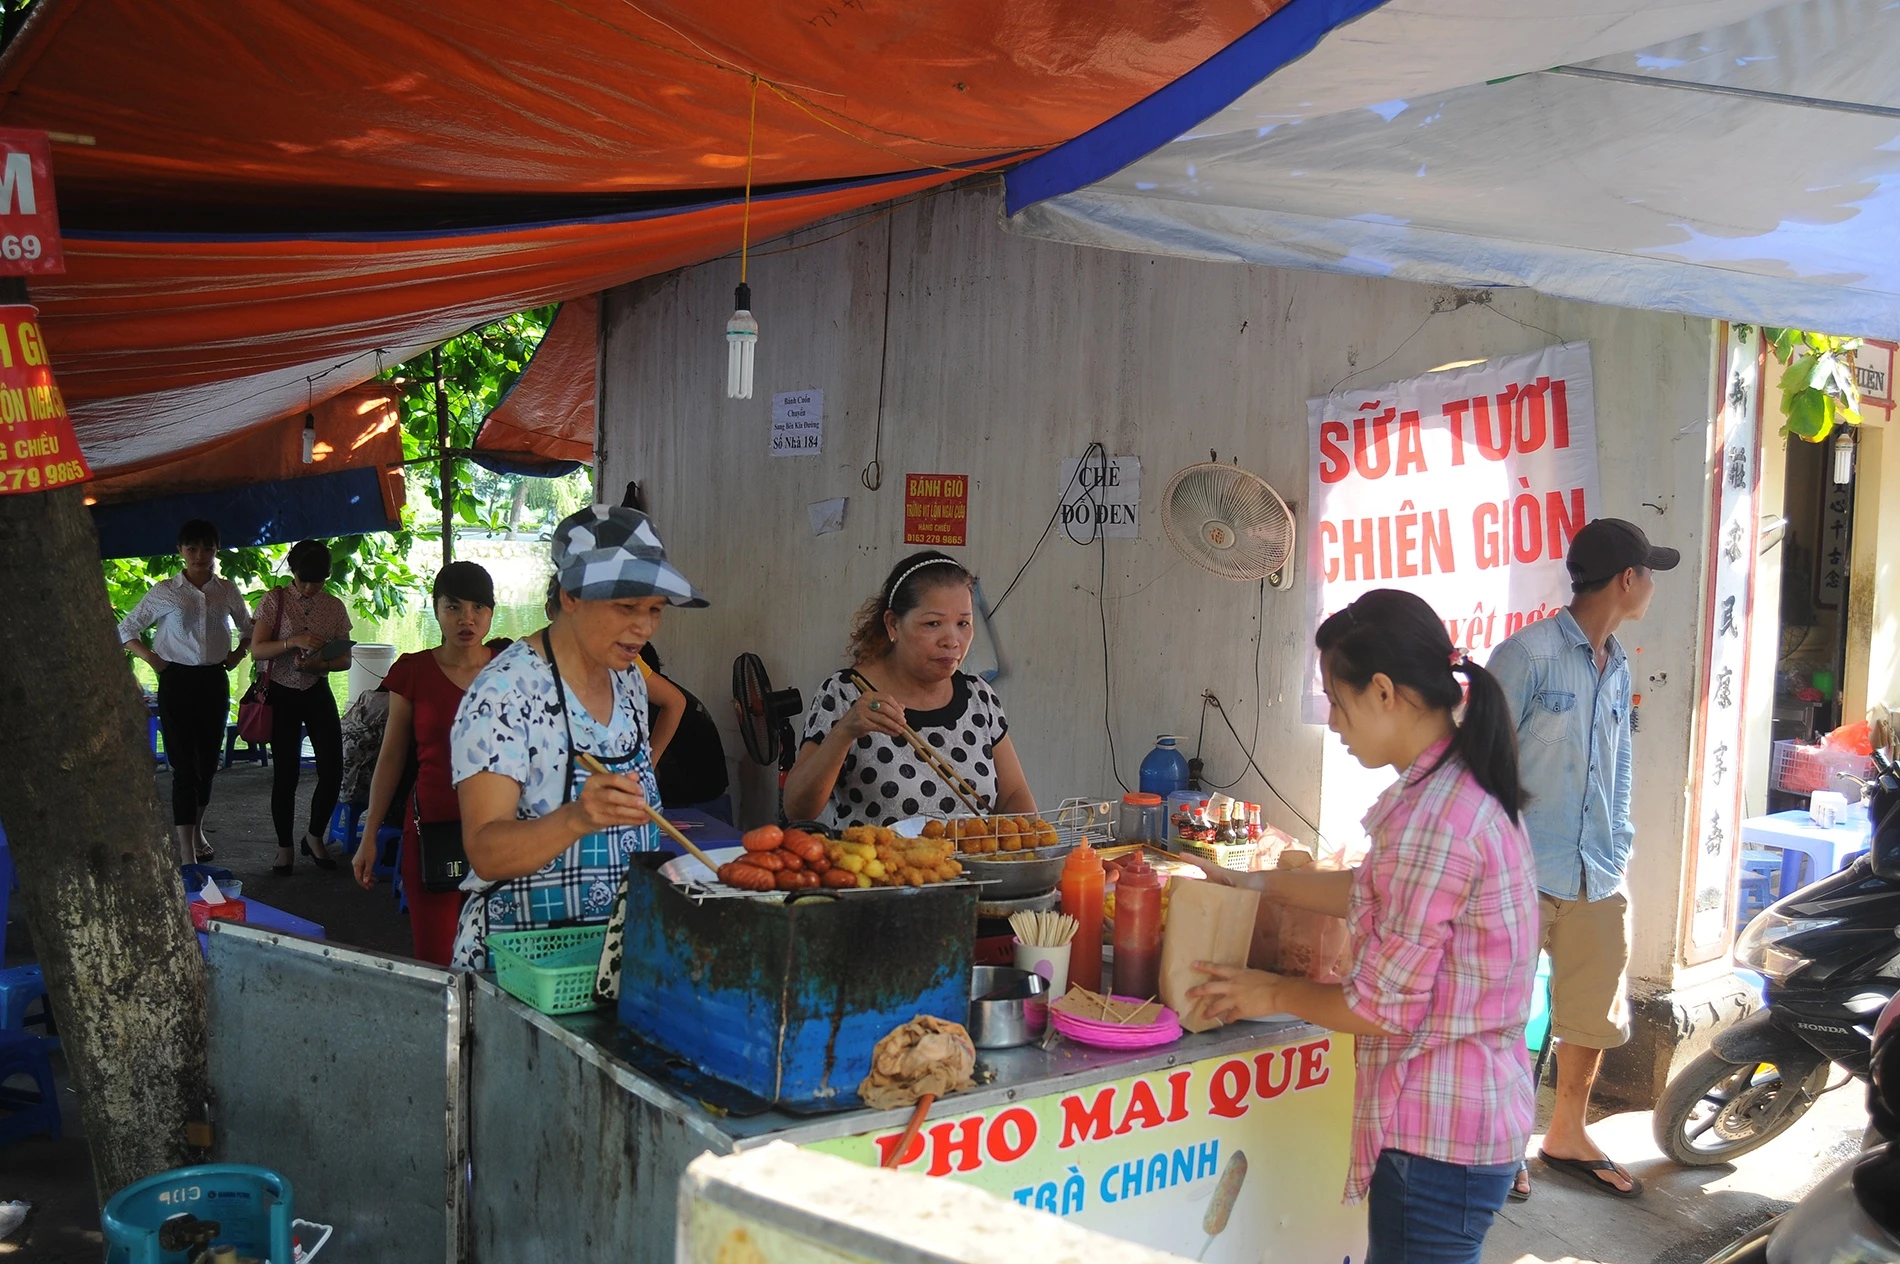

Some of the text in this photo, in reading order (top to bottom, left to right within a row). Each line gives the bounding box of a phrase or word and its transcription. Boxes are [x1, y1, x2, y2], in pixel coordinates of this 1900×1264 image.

[0, 234, 42, 260] 69
[0, 382, 28, 431] ỘN
[773, 433, 818, 450] Số Nhà 184
[1319, 376, 1569, 484] SỮA TƯƠI
[45, 460, 85, 485] 9865
[1078, 461, 1120, 488] CHÈ
[909, 476, 964, 498] BÁNH GIÒ
[1060, 498, 1137, 525] ĐỖ ĐEN
[907, 534, 963, 546] 0163 279 9865
[1320, 476, 1587, 583] CHIÊN GIÒN
[1797, 1022, 1849, 1035] HONDA
[873, 1038, 1332, 1177] PHO MAI QUE
[1013, 1138, 1220, 1217] TRÀ CHANH
